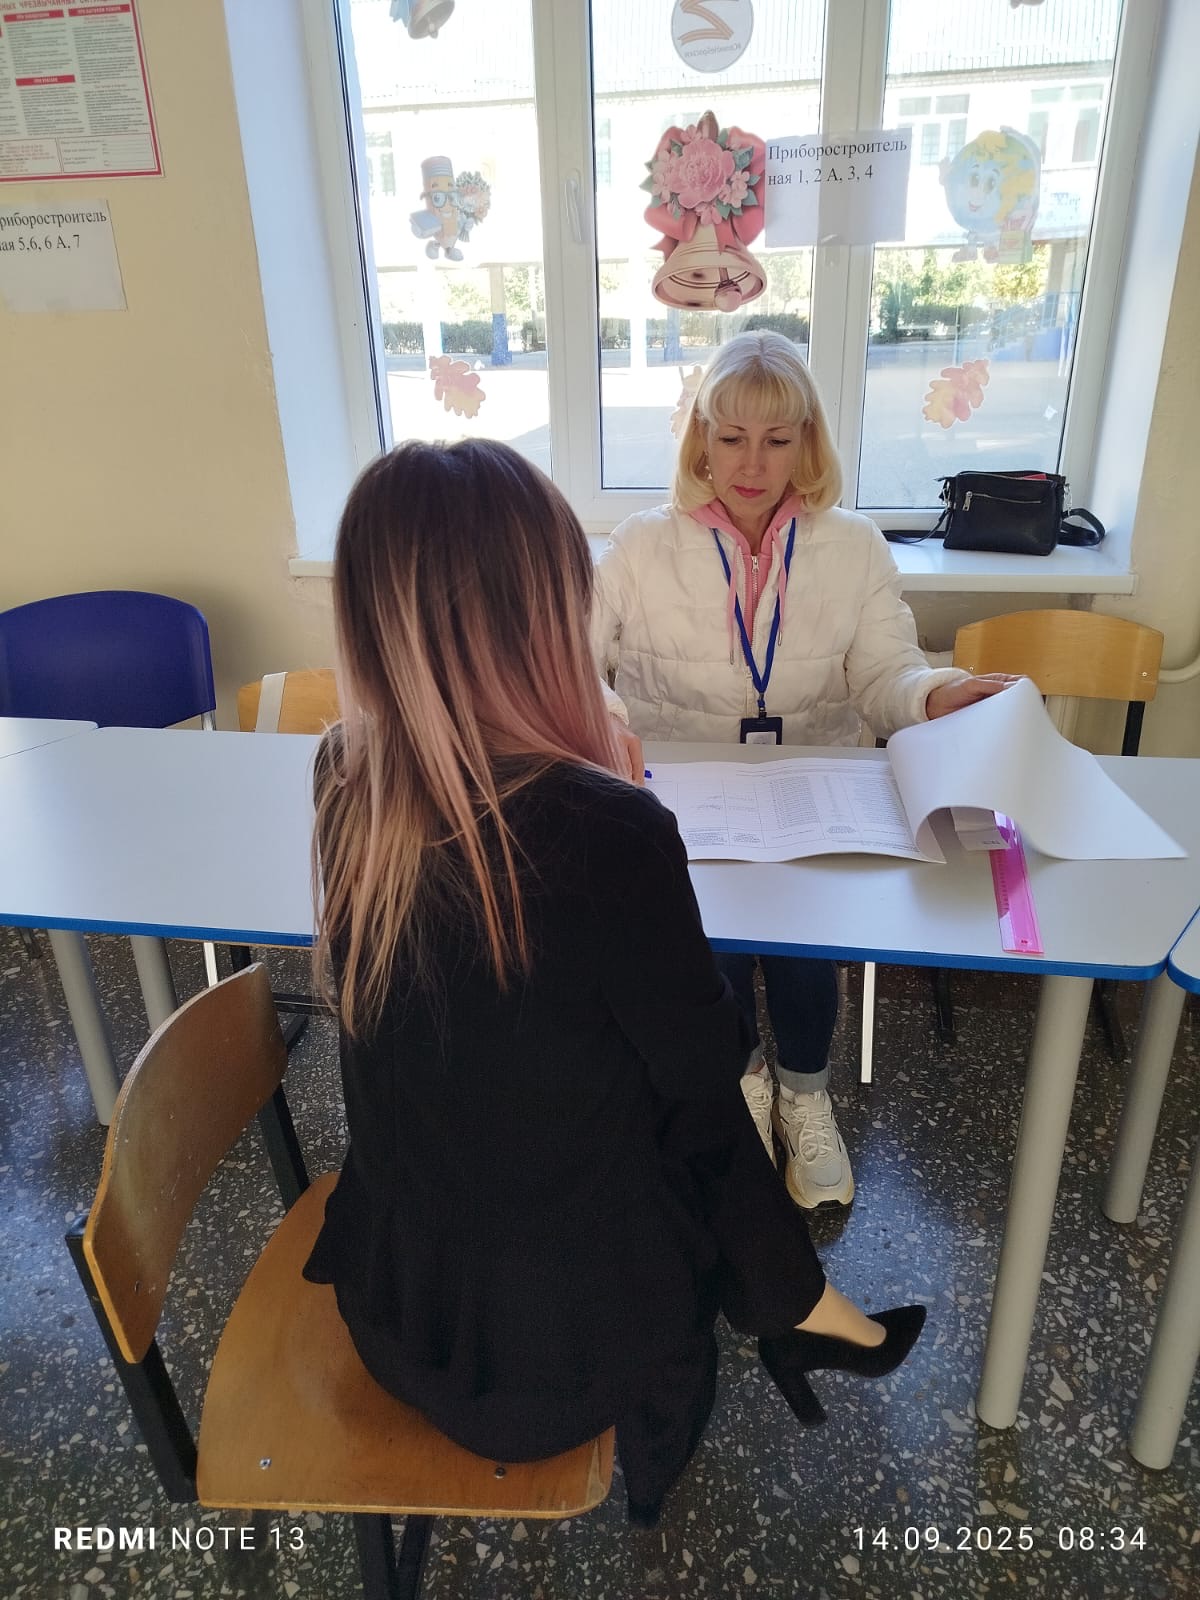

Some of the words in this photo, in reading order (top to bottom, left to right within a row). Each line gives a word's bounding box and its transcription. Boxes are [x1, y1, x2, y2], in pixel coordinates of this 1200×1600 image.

[769, 140, 907, 163] Приборостроитель
[767, 174, 792, 185] ная
[799, 169, 809, 184] 1,
[814, 168, 822, 182] 2
[864, 165, 873, 179] 4
[0, 212, 107, 231] риборостроитель
[44, 235, 52, 249] 6
[73, 234, 80, 248] 7
